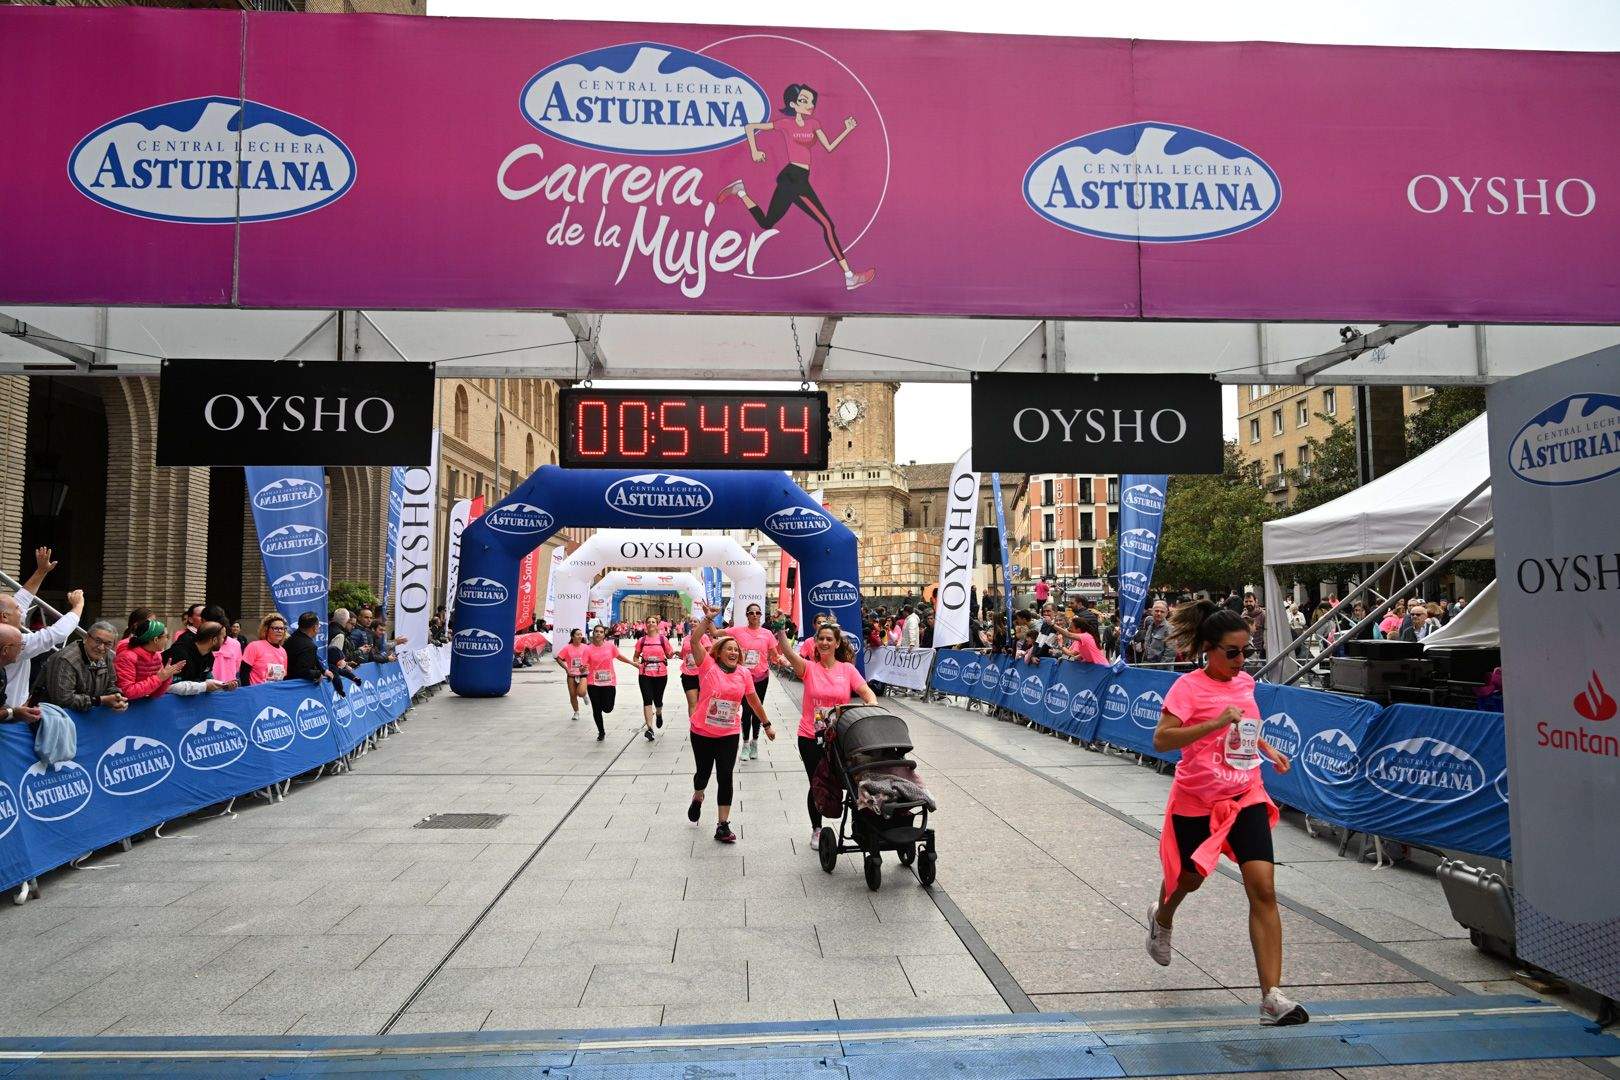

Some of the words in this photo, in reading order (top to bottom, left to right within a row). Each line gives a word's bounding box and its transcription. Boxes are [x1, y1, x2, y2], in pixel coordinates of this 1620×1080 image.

[539, 80, 750, 128] ASTURIANA
[579, 79, 655, 93] CENTRAL
[664, 82, 743, 96] LECHERA
[136, 140, 226, 153] CENTRAL
[234, 140, 326, 154] LECHERA
[90, 141, 333, 191] ASTURIANA
[496, 143, 704, 207] Carrera
[1083, 162, 1163, 176] CENTRAL
[1172, 164, 1254, 177] LECHERA
[1043, 165, 1263, 211] ASTURIANA
[1407, 173, 1597, 217] OYSHO
[546, 206, 585, 248] de
[593, 206, 622, 249] la
[614, 200, 780, 299] Mujer
[204, 393, 395, 434] OYSHO
[1012, 407, 1188, 444] OYSHO
[1536, 425, 1582, 442] CENTRAL
[613, 486, 706, 507] ASTURIANA
[1056, 483, 1064, 523] HOTEL
[489, 513, 548, 528] ASTURIANA
[770, 518, 828, 531] ASTURIANA
[400, 466, 432, 613] OYSHO
[620, 541, 704, 559] OYSHO
[942, 473, 976, 610] OYSHO
[812, 590, 857, 602] ASTURIANA
[256, 723, 294, 744] ASTURIANA
[300, 714, 329, 732] ASTURIANA
[110, 753, 136, 767] CENTRAL
[186, 736, 245, 763] ASTURIANA
[103, 754, 171, 788] ASTURIANA
[1370, 756, 1474, 792] ASTURIANA
[26, 778, 90, 811] ASTURIANA
